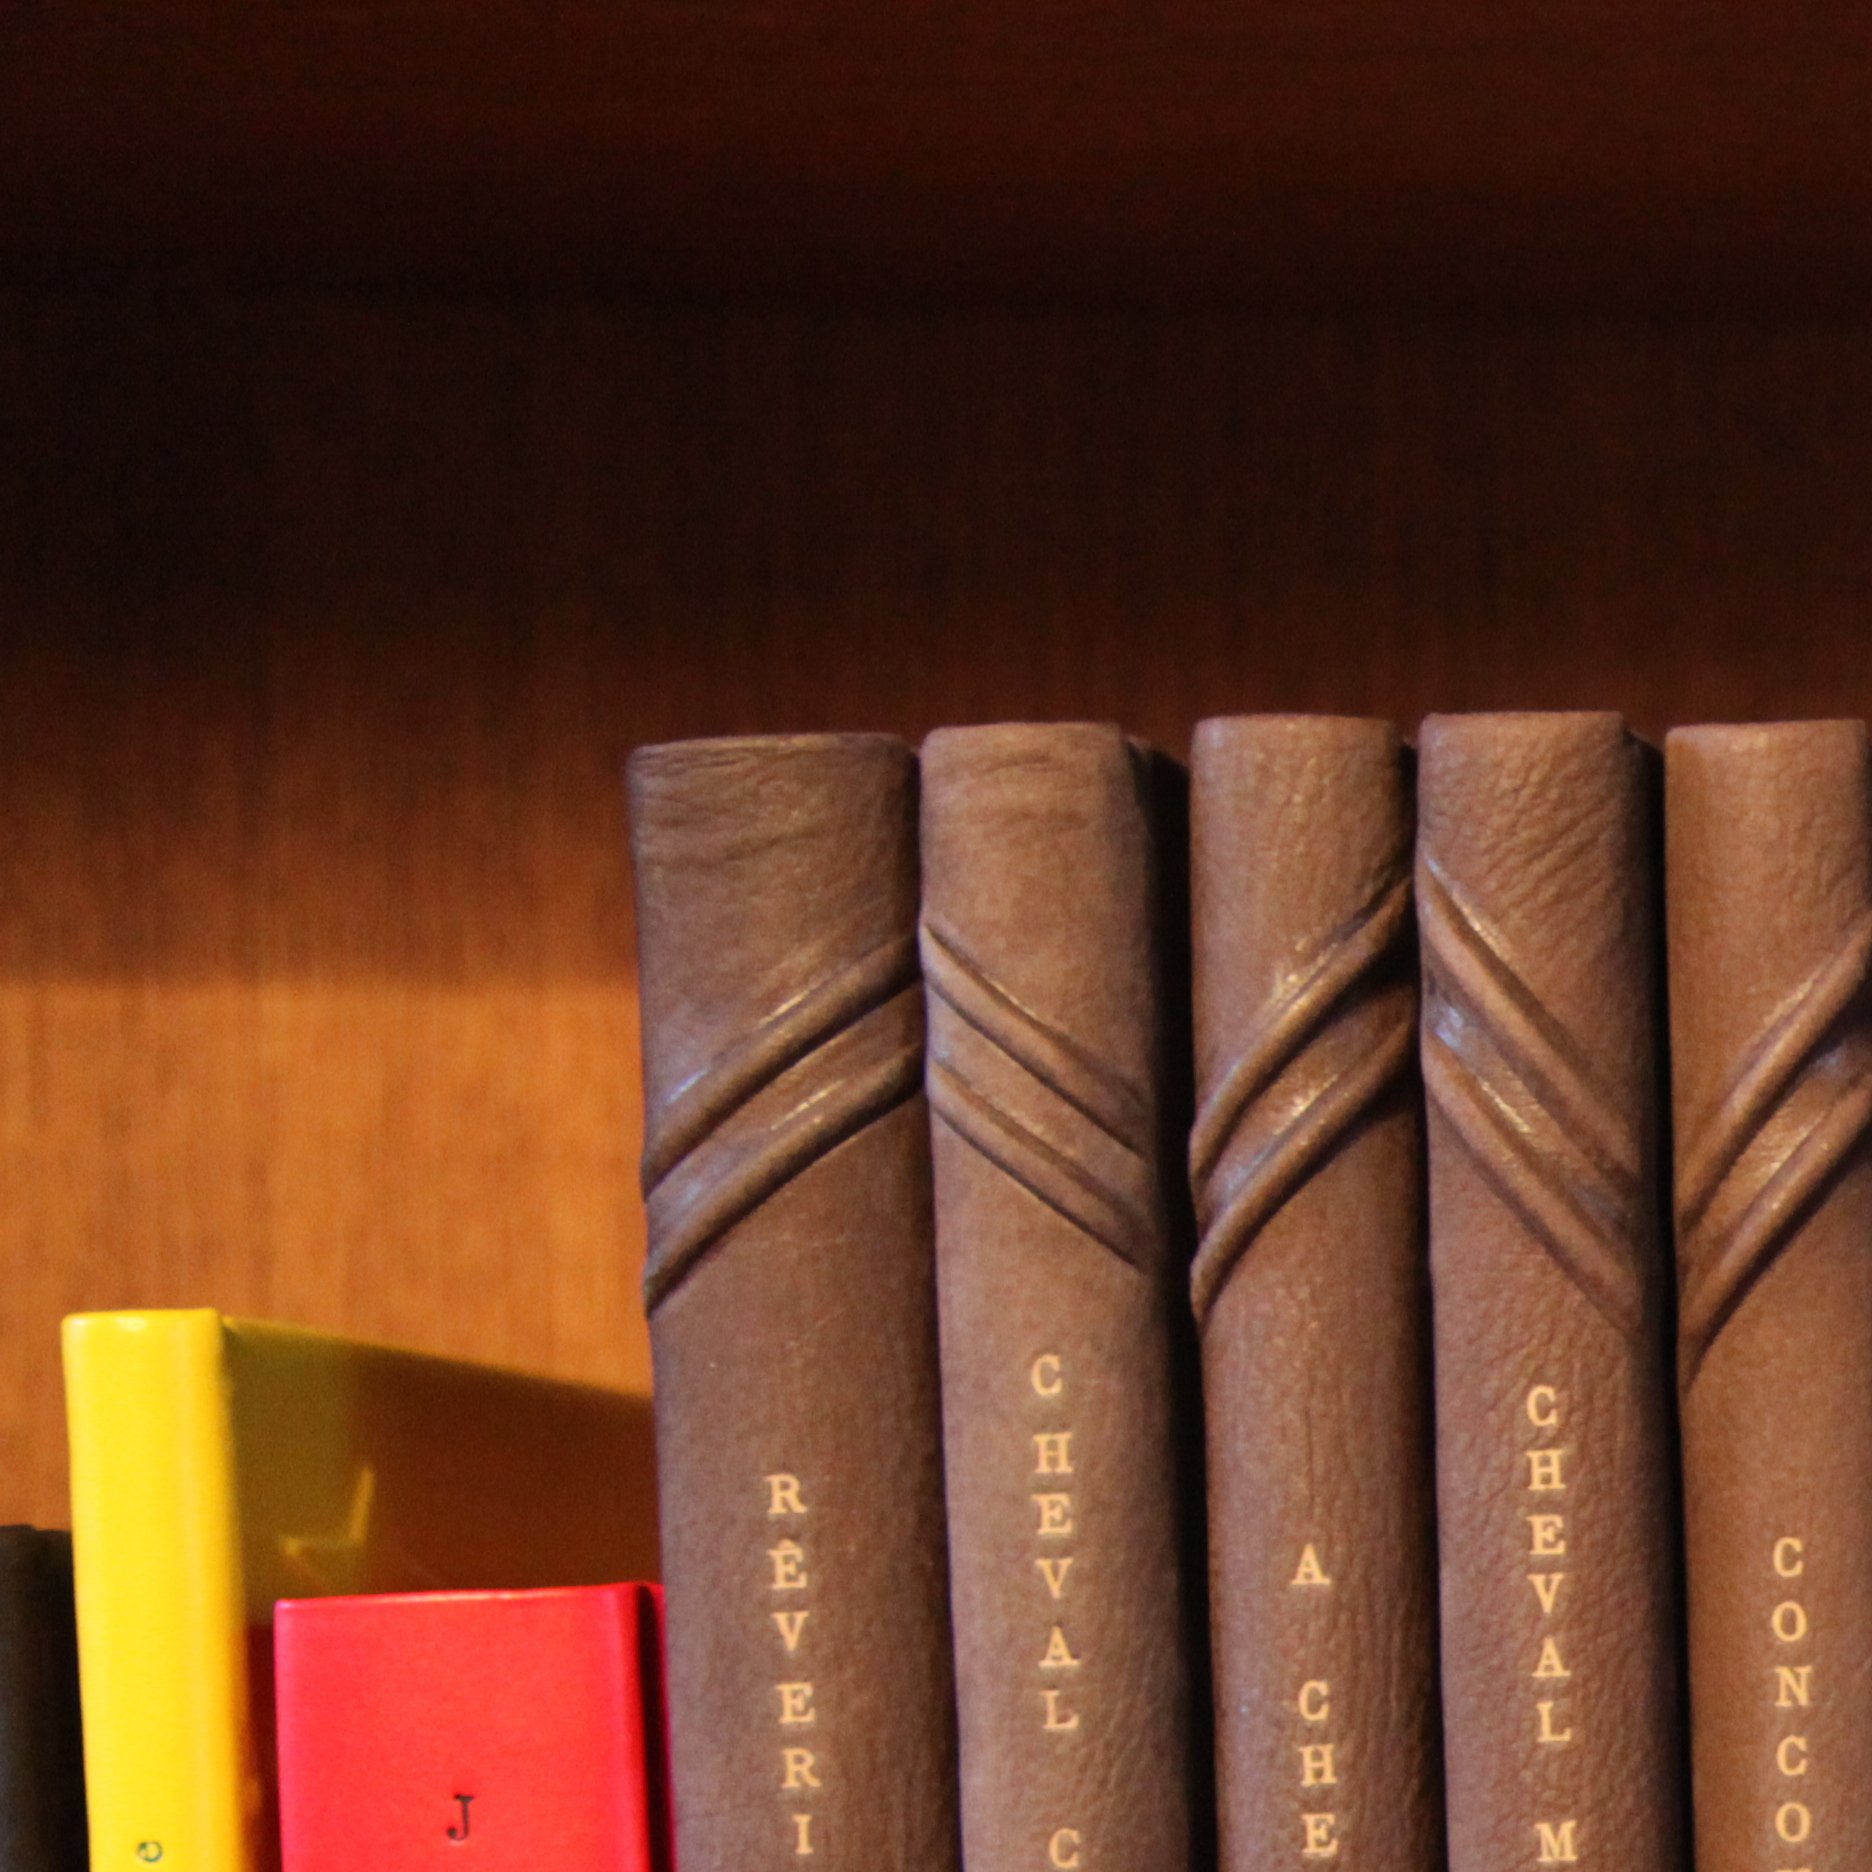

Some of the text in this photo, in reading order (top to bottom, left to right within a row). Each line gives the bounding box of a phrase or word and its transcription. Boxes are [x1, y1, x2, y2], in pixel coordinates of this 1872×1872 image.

[1030, 1352, 1081, 1734] CHEVAL
[1291, 1544, 1331, 1588] A
[1525, 1385, 1573, 1745] CHEVAL
